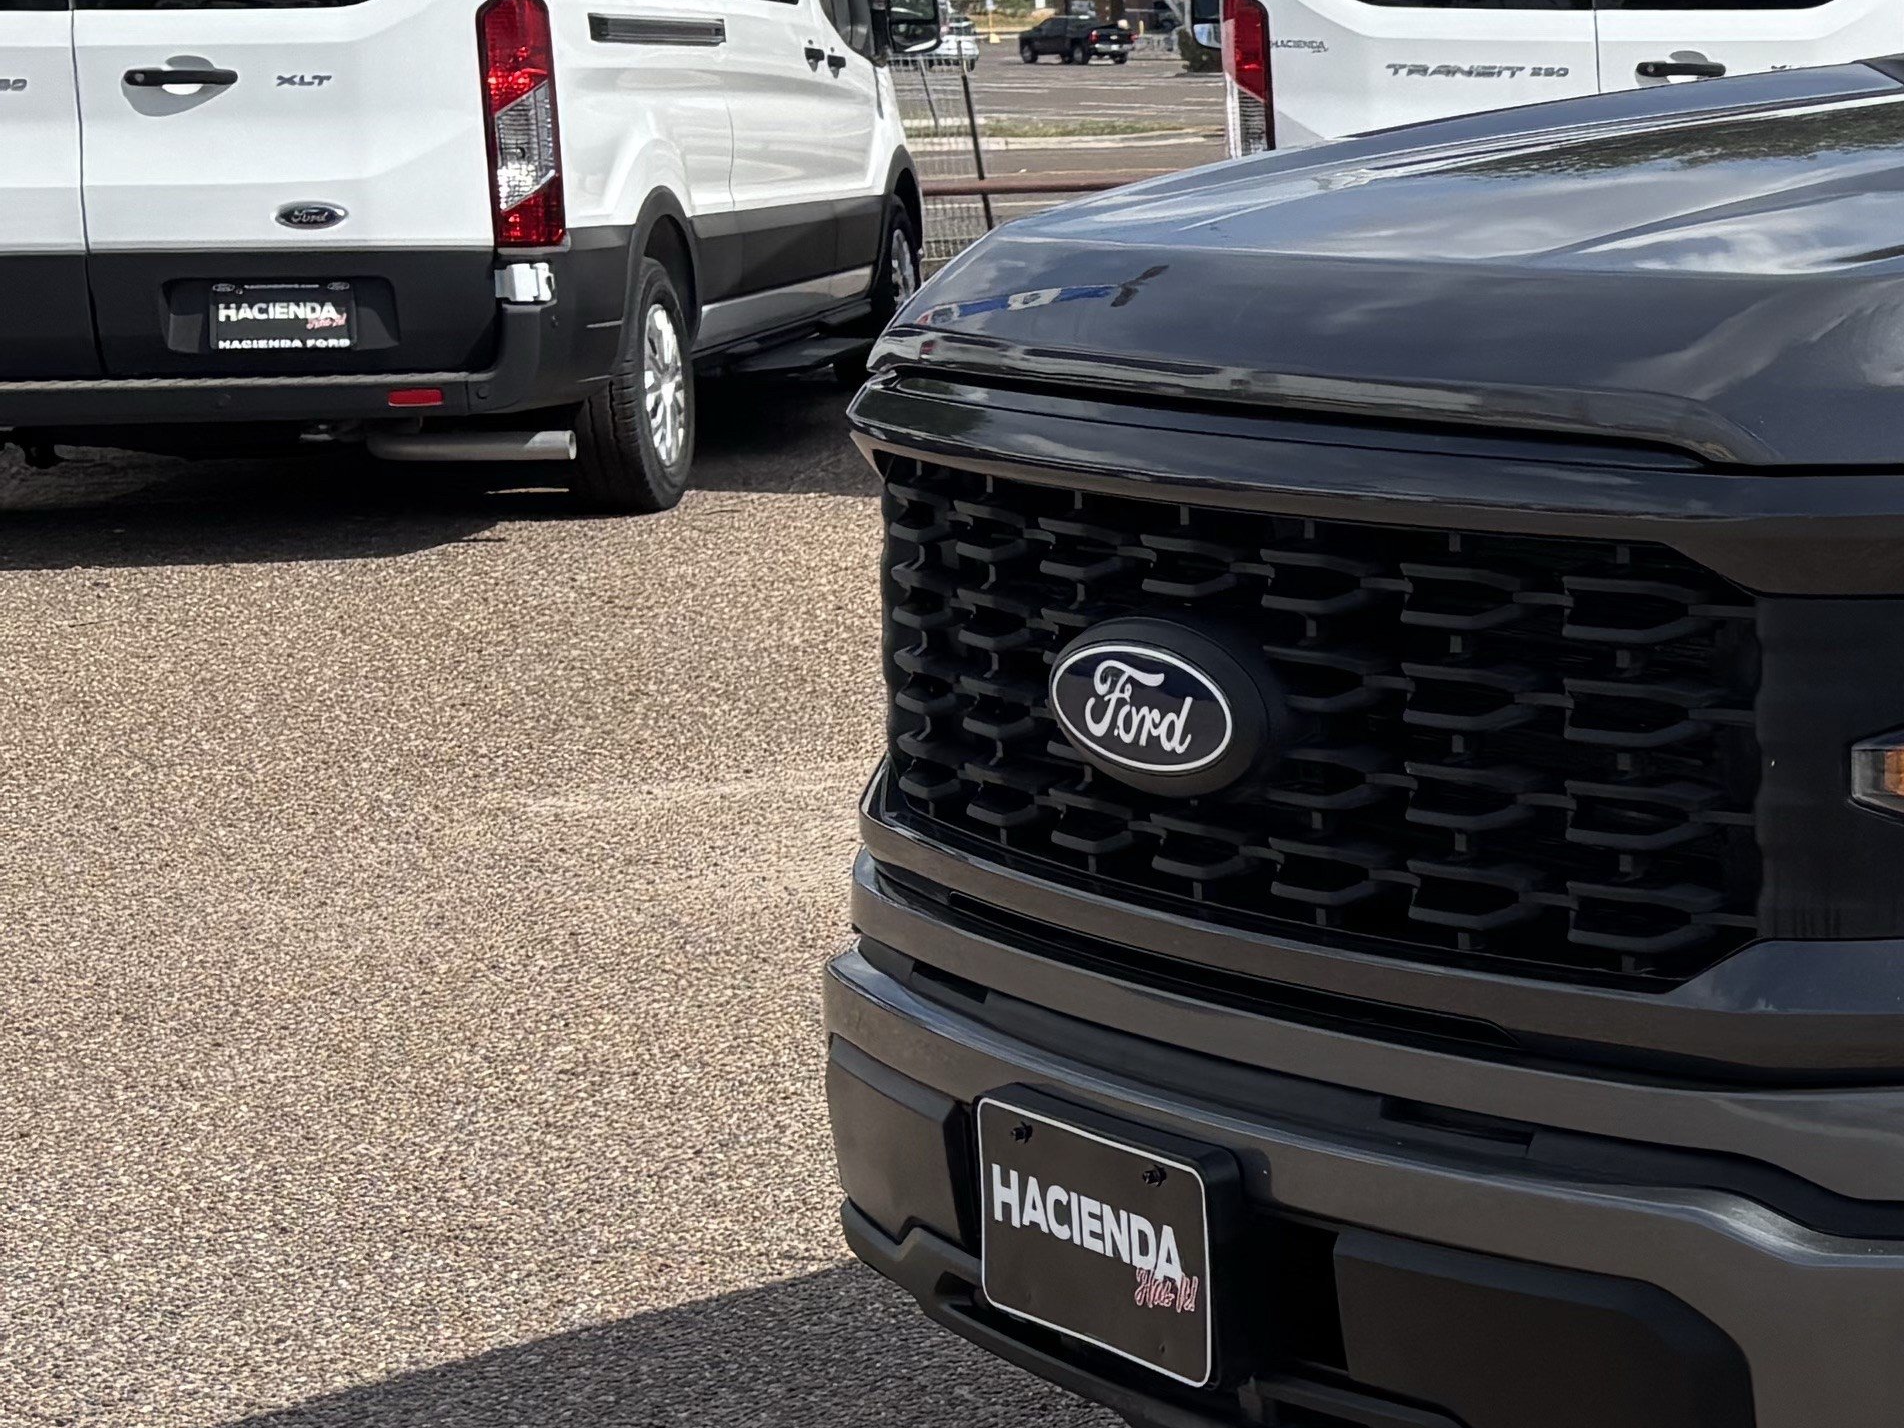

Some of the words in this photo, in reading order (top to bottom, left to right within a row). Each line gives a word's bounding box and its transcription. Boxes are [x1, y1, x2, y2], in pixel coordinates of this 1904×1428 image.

[276, 74, 332, 87] XLT
[1385, 63, 1526, 79] TRANSIT
[218, 302, 337, 323] HACIENDA
[1084, 659, 1194, 755] Ford
[991, 1162, 1185, 1289] HACIENDA
[1134, 1266, 1174, 1309] Has
